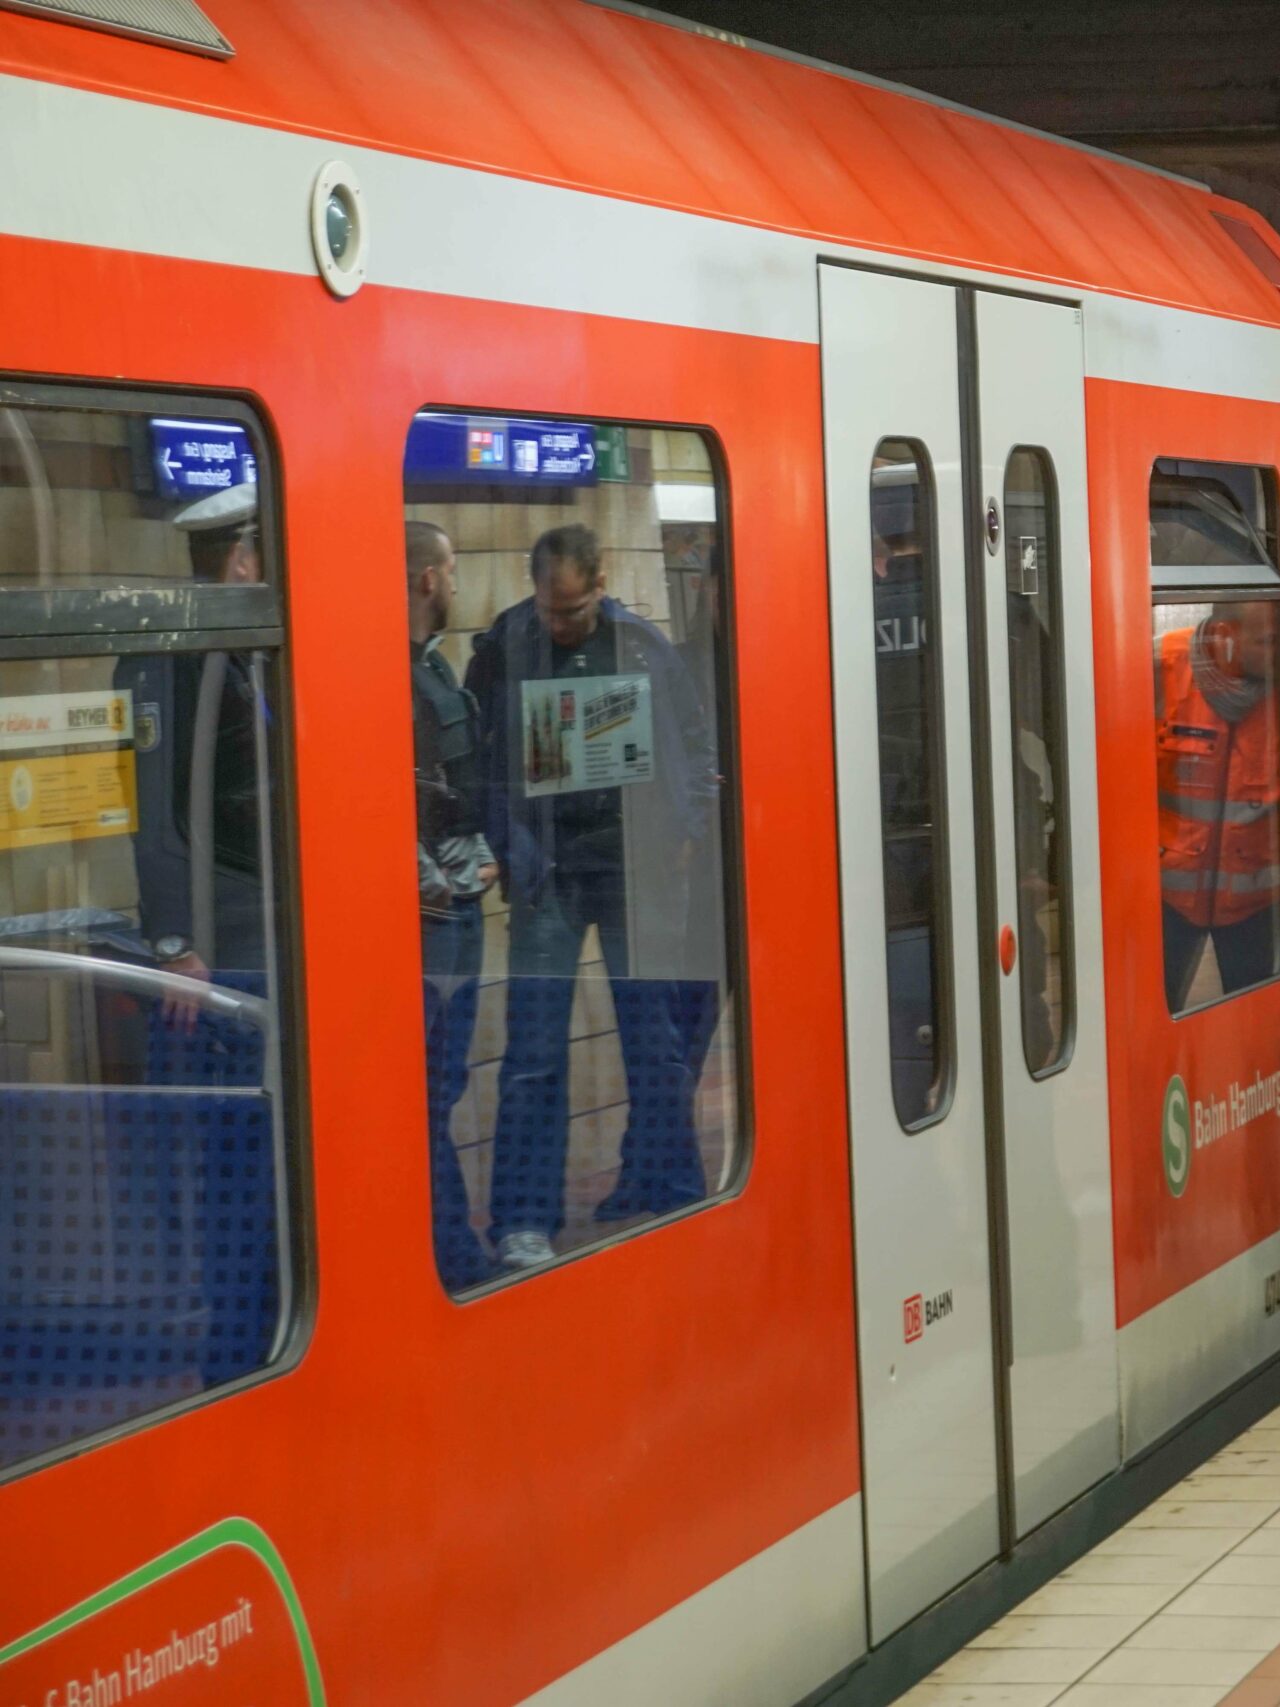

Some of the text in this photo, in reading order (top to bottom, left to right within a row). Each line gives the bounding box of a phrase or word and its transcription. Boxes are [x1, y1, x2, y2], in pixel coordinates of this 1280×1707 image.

[1166, 1087, 1188, 1186] S
[1193, 1092, 1228, 1150] Bahn
[904, 1288, 953, 1340] DB BAHN
[124, 1621, 219, 1697] Hamburg
[220, 1597, 253, 1647] mit
